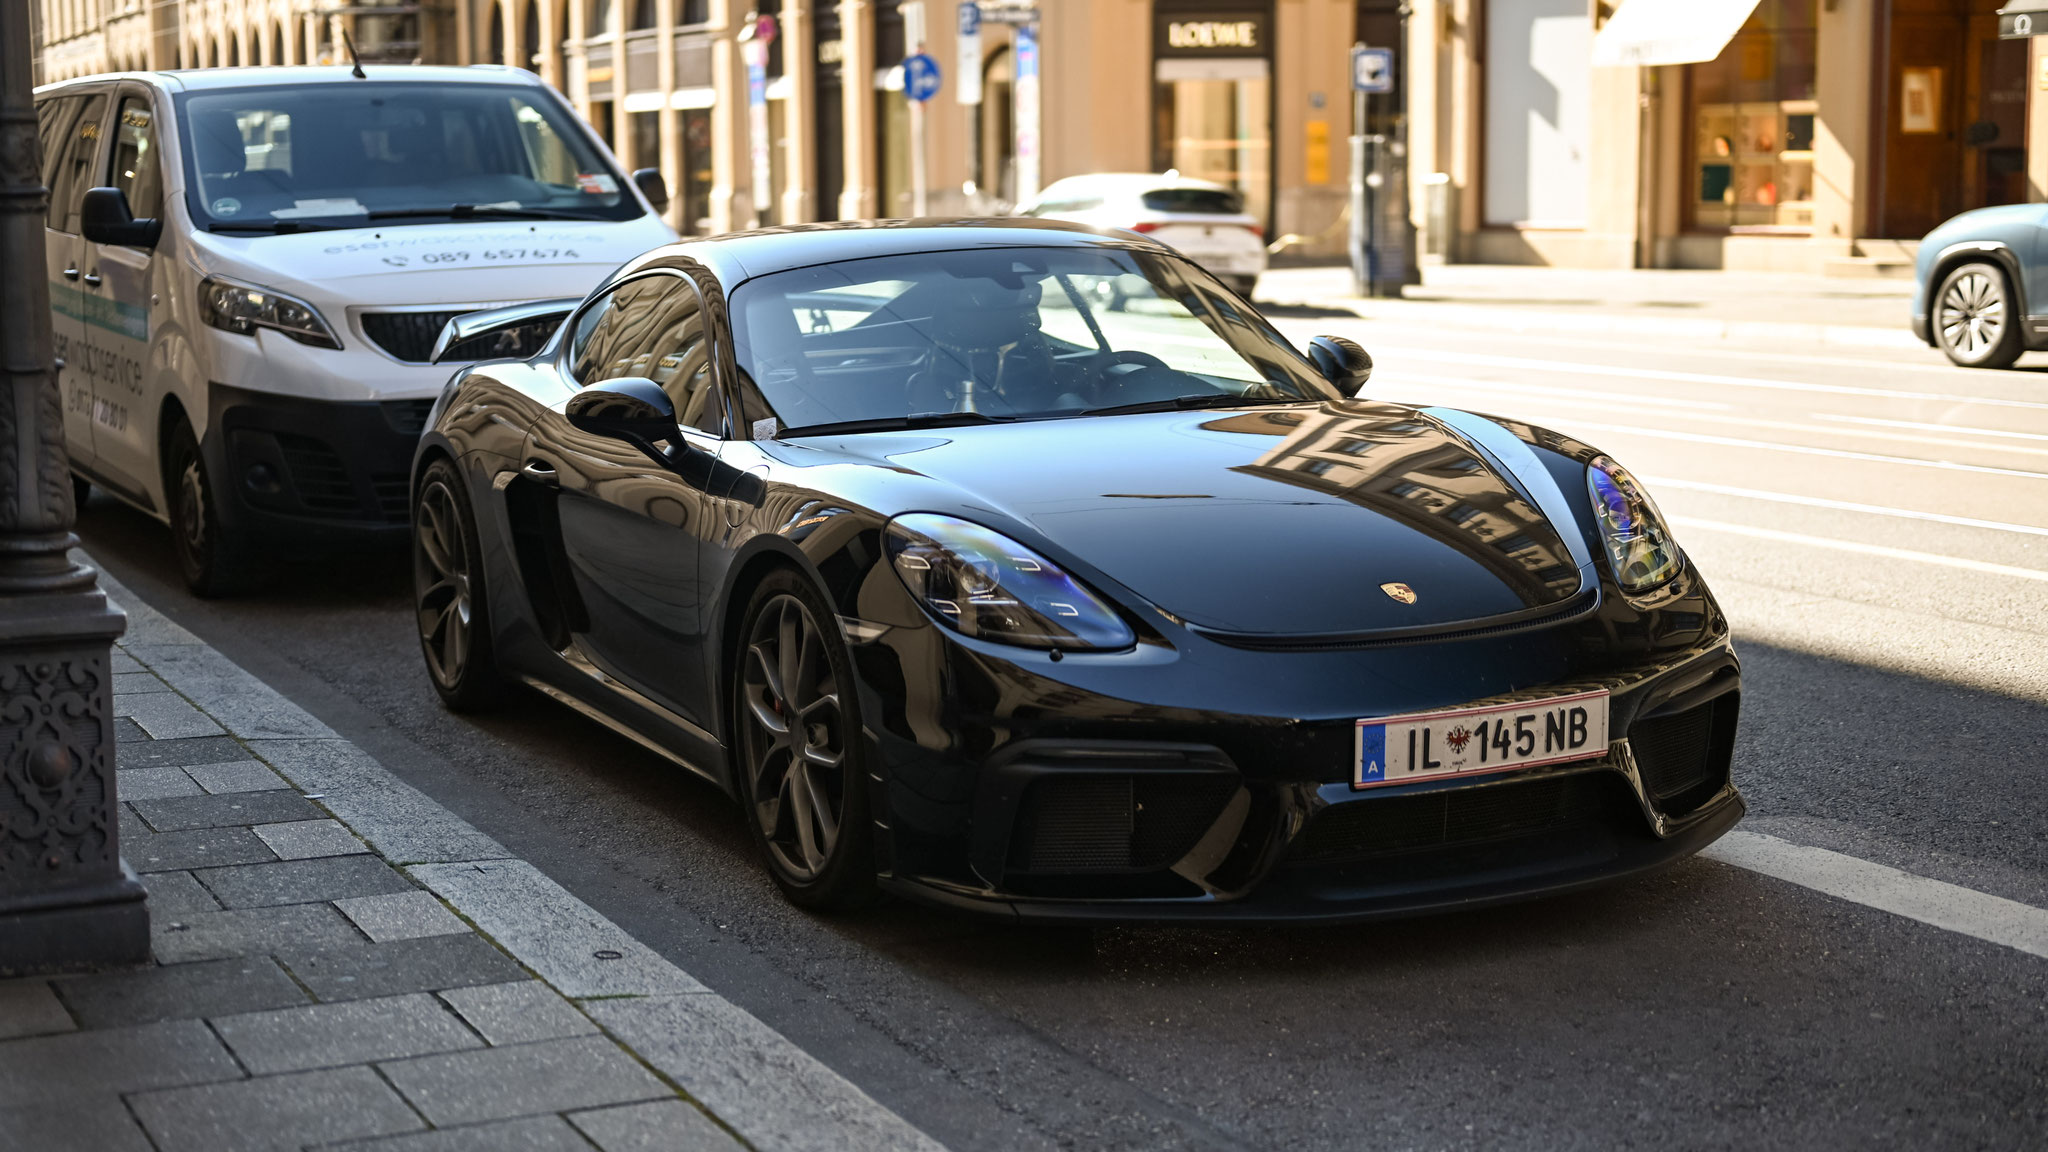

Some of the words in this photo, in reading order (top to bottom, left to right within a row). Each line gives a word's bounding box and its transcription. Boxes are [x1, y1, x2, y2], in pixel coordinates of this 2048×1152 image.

[1169, 22, 1257, 47] LOEWE
[421, 251, 471, 265] 089
[1409, 728, 1441, 771] IL
[1474, 714, 1536, 763] 145
[1546, 706, 1588, 753] NB
[1367, 760, 1379, 775] A
